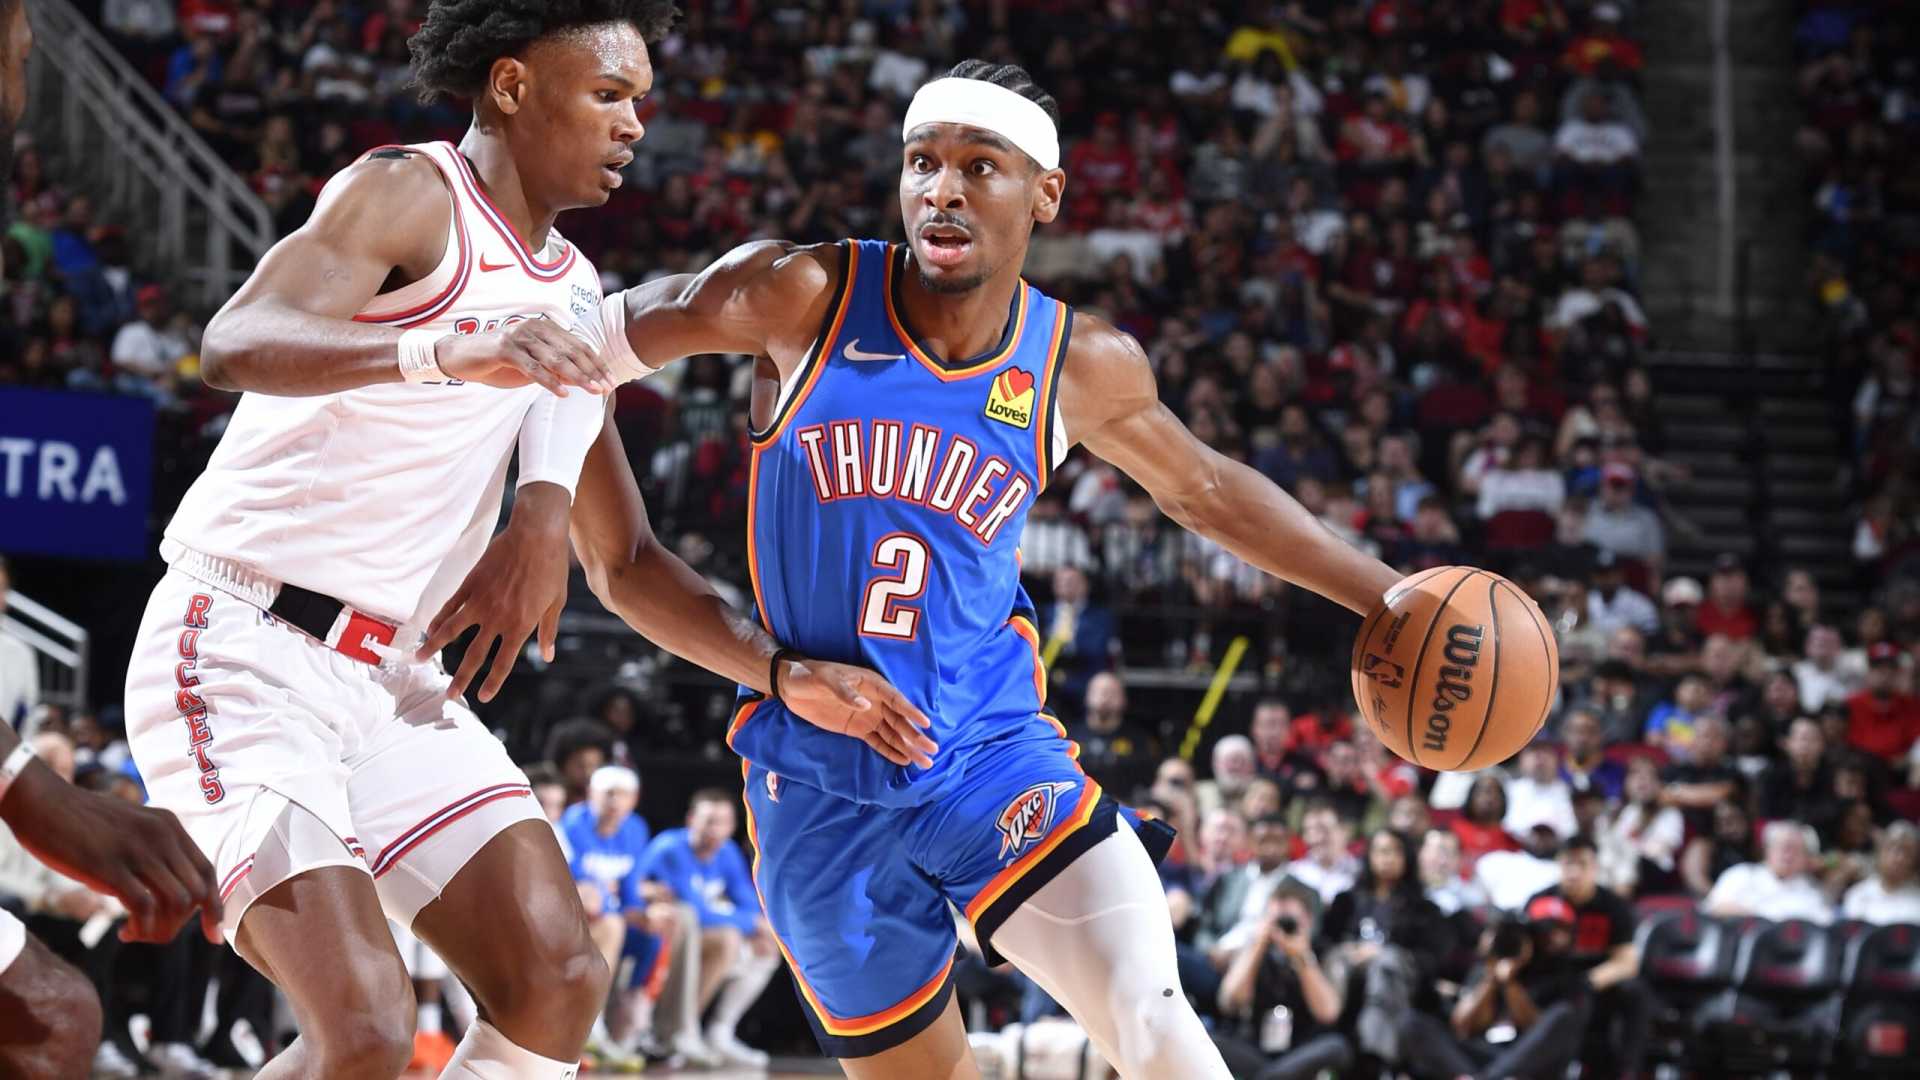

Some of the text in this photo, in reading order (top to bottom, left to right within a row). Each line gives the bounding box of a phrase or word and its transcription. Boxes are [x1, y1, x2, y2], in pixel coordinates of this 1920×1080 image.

[0, 437, 127, 506] TRA
[797, 418, 1032, 548] THUNDER
[858, 532, 932, 641] 2
[1424, 624, 1486, 751] Wilson
[1008, 792, 1041, 851] OKC
